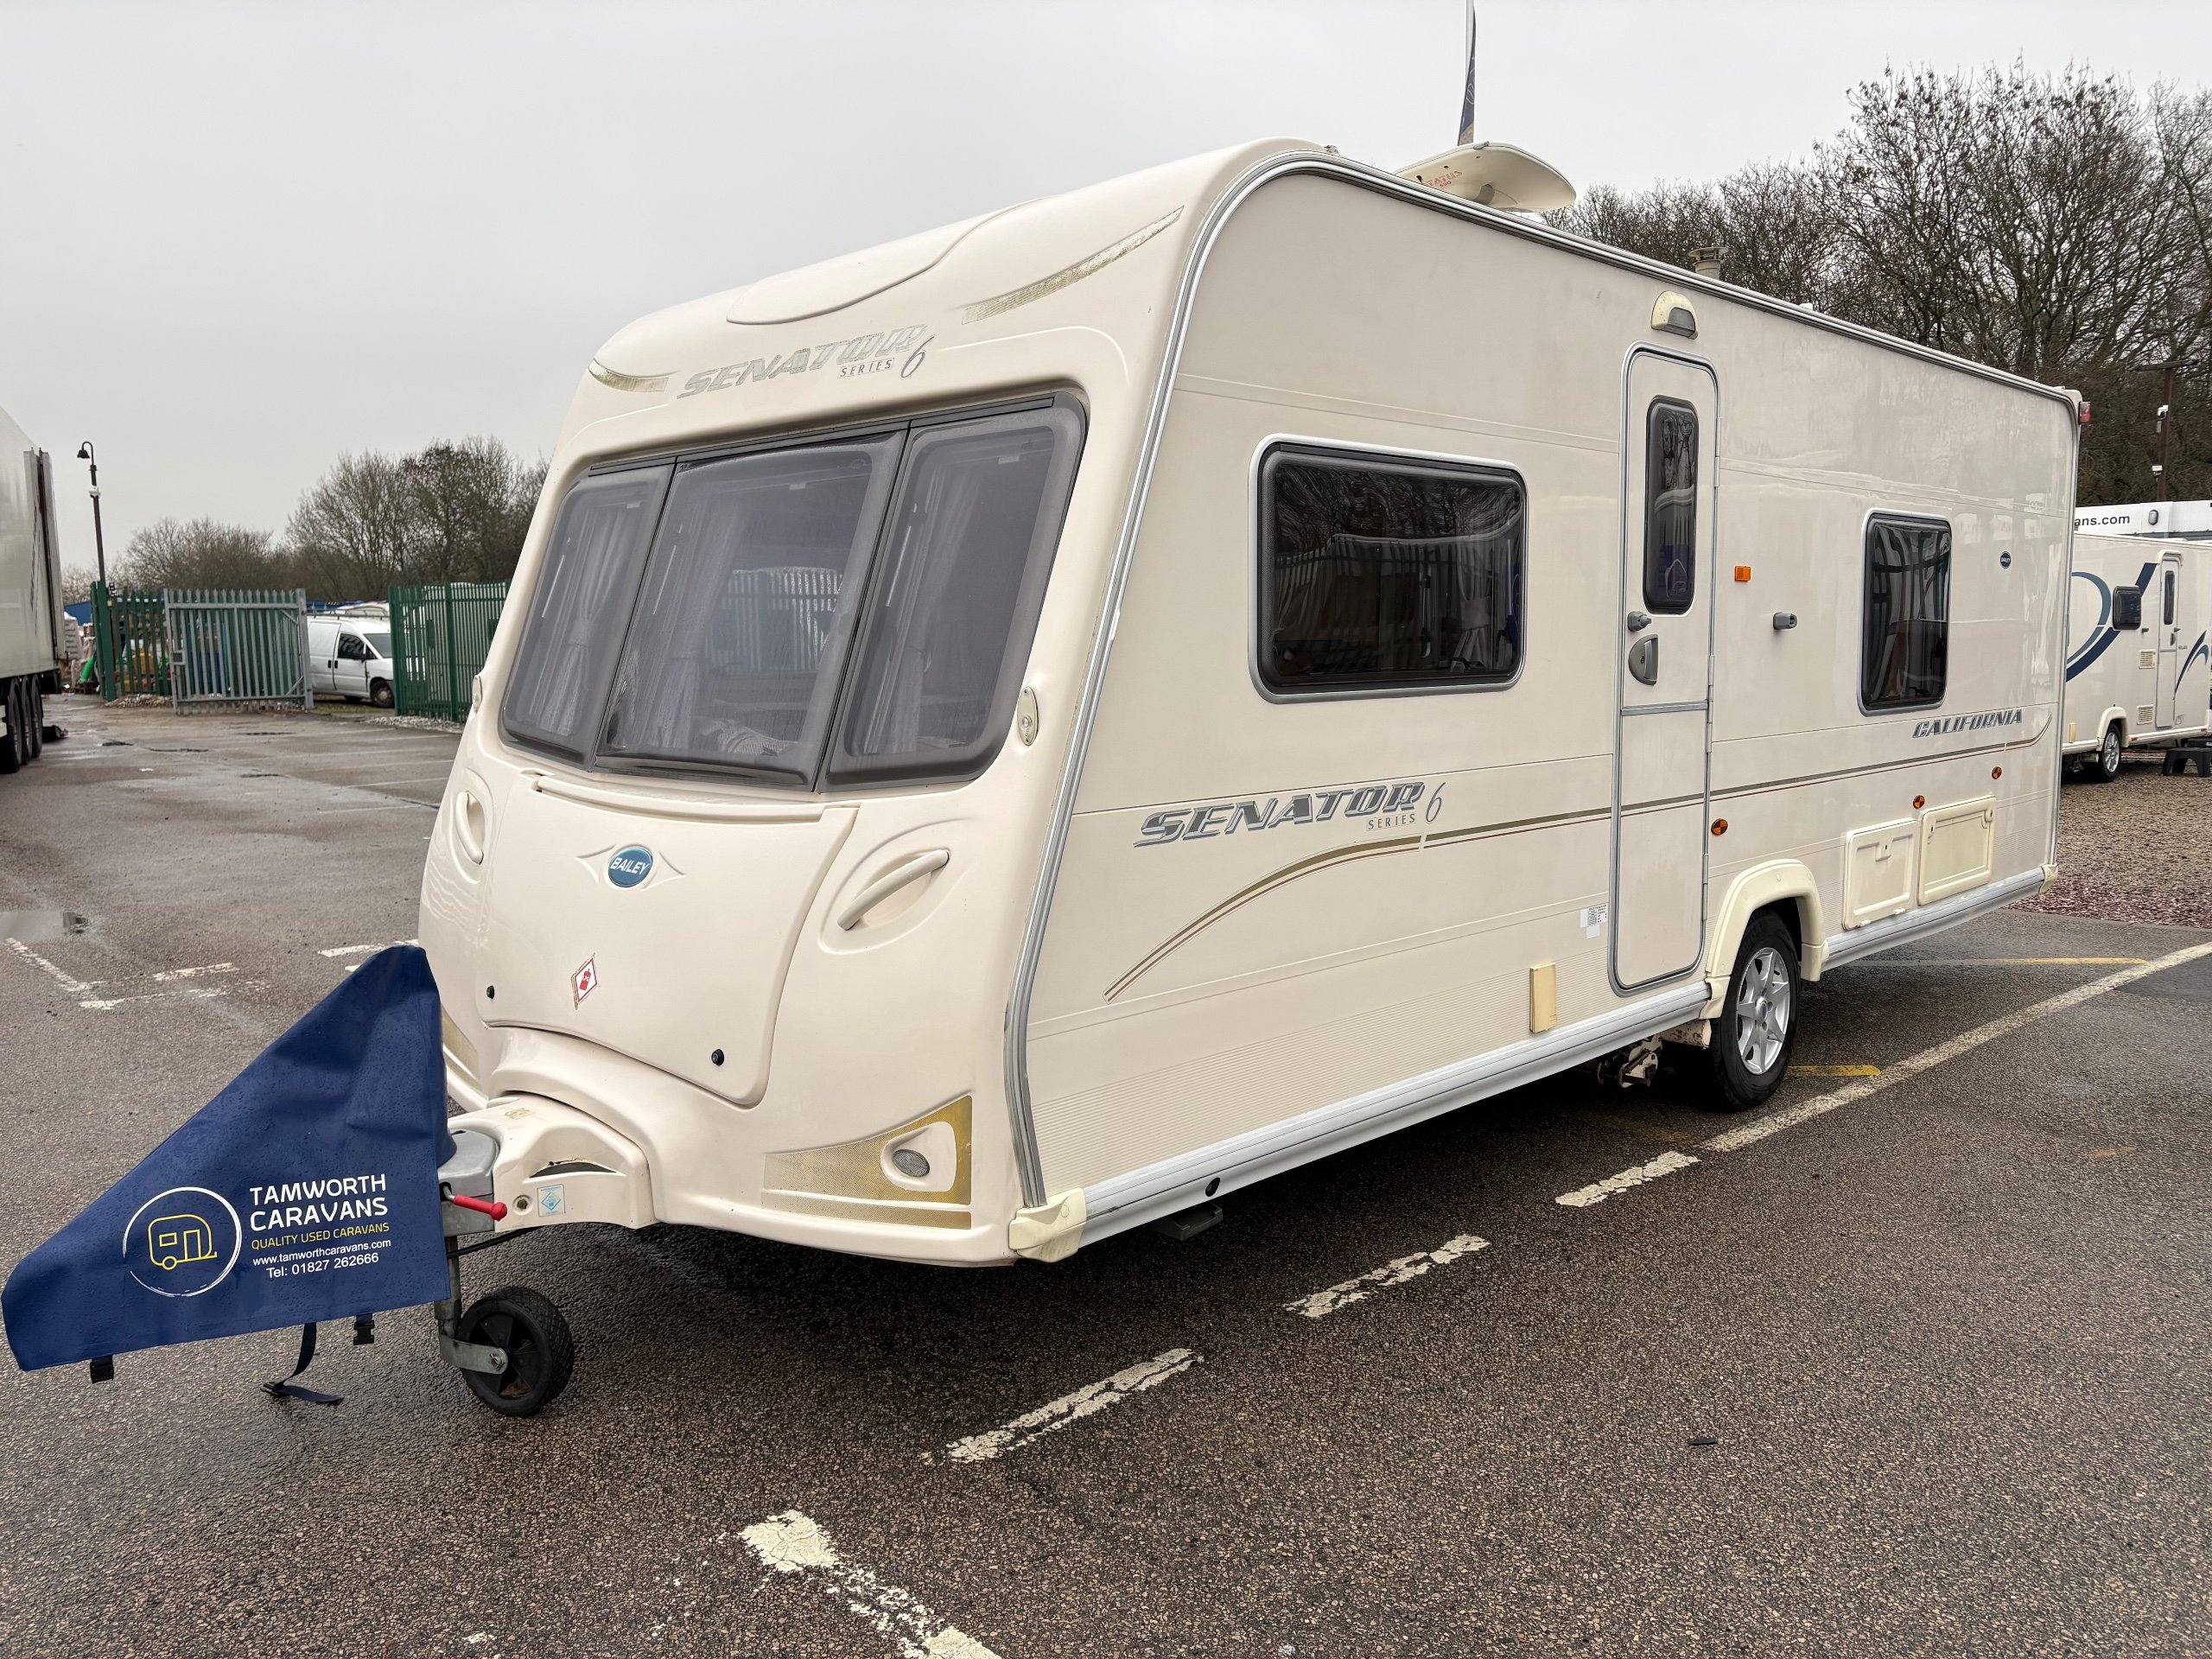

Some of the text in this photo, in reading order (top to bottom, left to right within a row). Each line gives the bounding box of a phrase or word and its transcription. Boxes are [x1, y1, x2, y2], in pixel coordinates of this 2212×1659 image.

[1426, 171, 1462, 186] TATUS
[677, 325, 928, 399] SENATOR
[840, 334, 935, 378] SERIES 6
[2075, 516, 2130, 526] ans.com
[1912, 709, 2022, 738] CALIFORNIA
[1133, 781, 1426, 848] SENATOR
[1368, 782, 1446, 830] SERIES 6
[610, 857, 650, 874] BAILEY
[250, 1173, 386, 1206] TAMWORTH
[250, 1197, 388, 1232] CARAVANS
[251, 1222, 390, 1250] QUALITY USED CARAVANS
[252, 1239, 391, 1266] www.tamworthcaravans.com
[266, 1252, 379, 1279] Tel: 01827 262666
